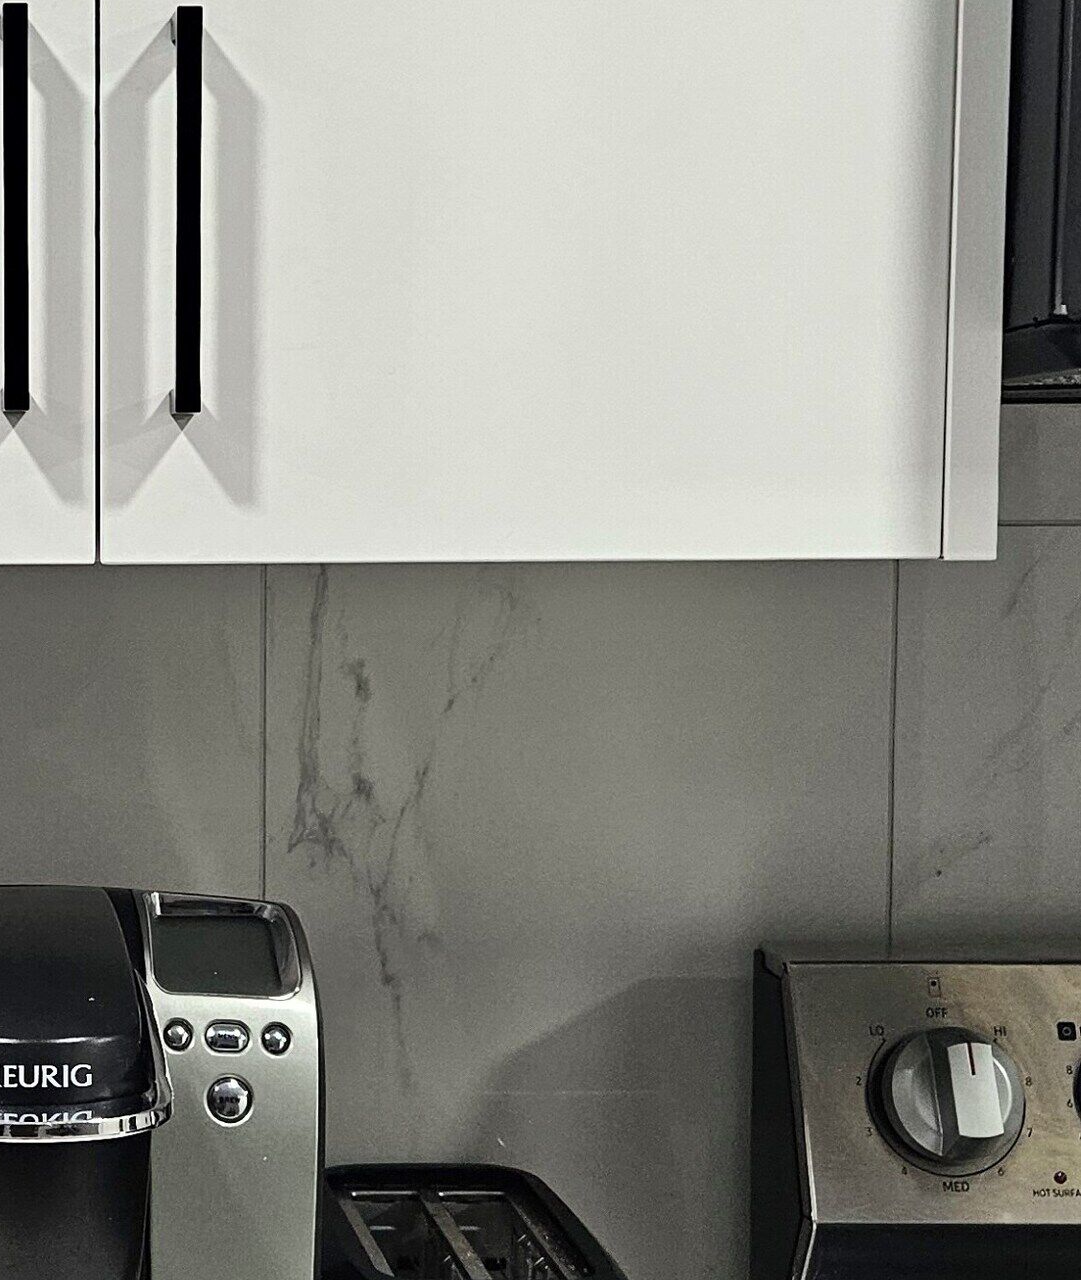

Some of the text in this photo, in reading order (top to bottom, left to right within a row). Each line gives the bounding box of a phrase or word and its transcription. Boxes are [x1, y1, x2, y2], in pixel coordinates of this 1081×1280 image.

[925, 1007, 948, 1018] OFF
[868, 1025, 885, 1036] LO
[993, 1026, 1007, 1037] HI
[1065, 1065, 1073, 1075] 8
[855, 1076, 862, 1086] 2
[1024, 1076, 1032, 1086] 8
[1066, 1099, 1073, 1108] 6
[1027, 1127, 1034, 1138] 7
[997, 1167, 1005, 1177] 6
[942, 1181, 970, 1192] MED
[1032, 1187, 1051, 1198] HOT
